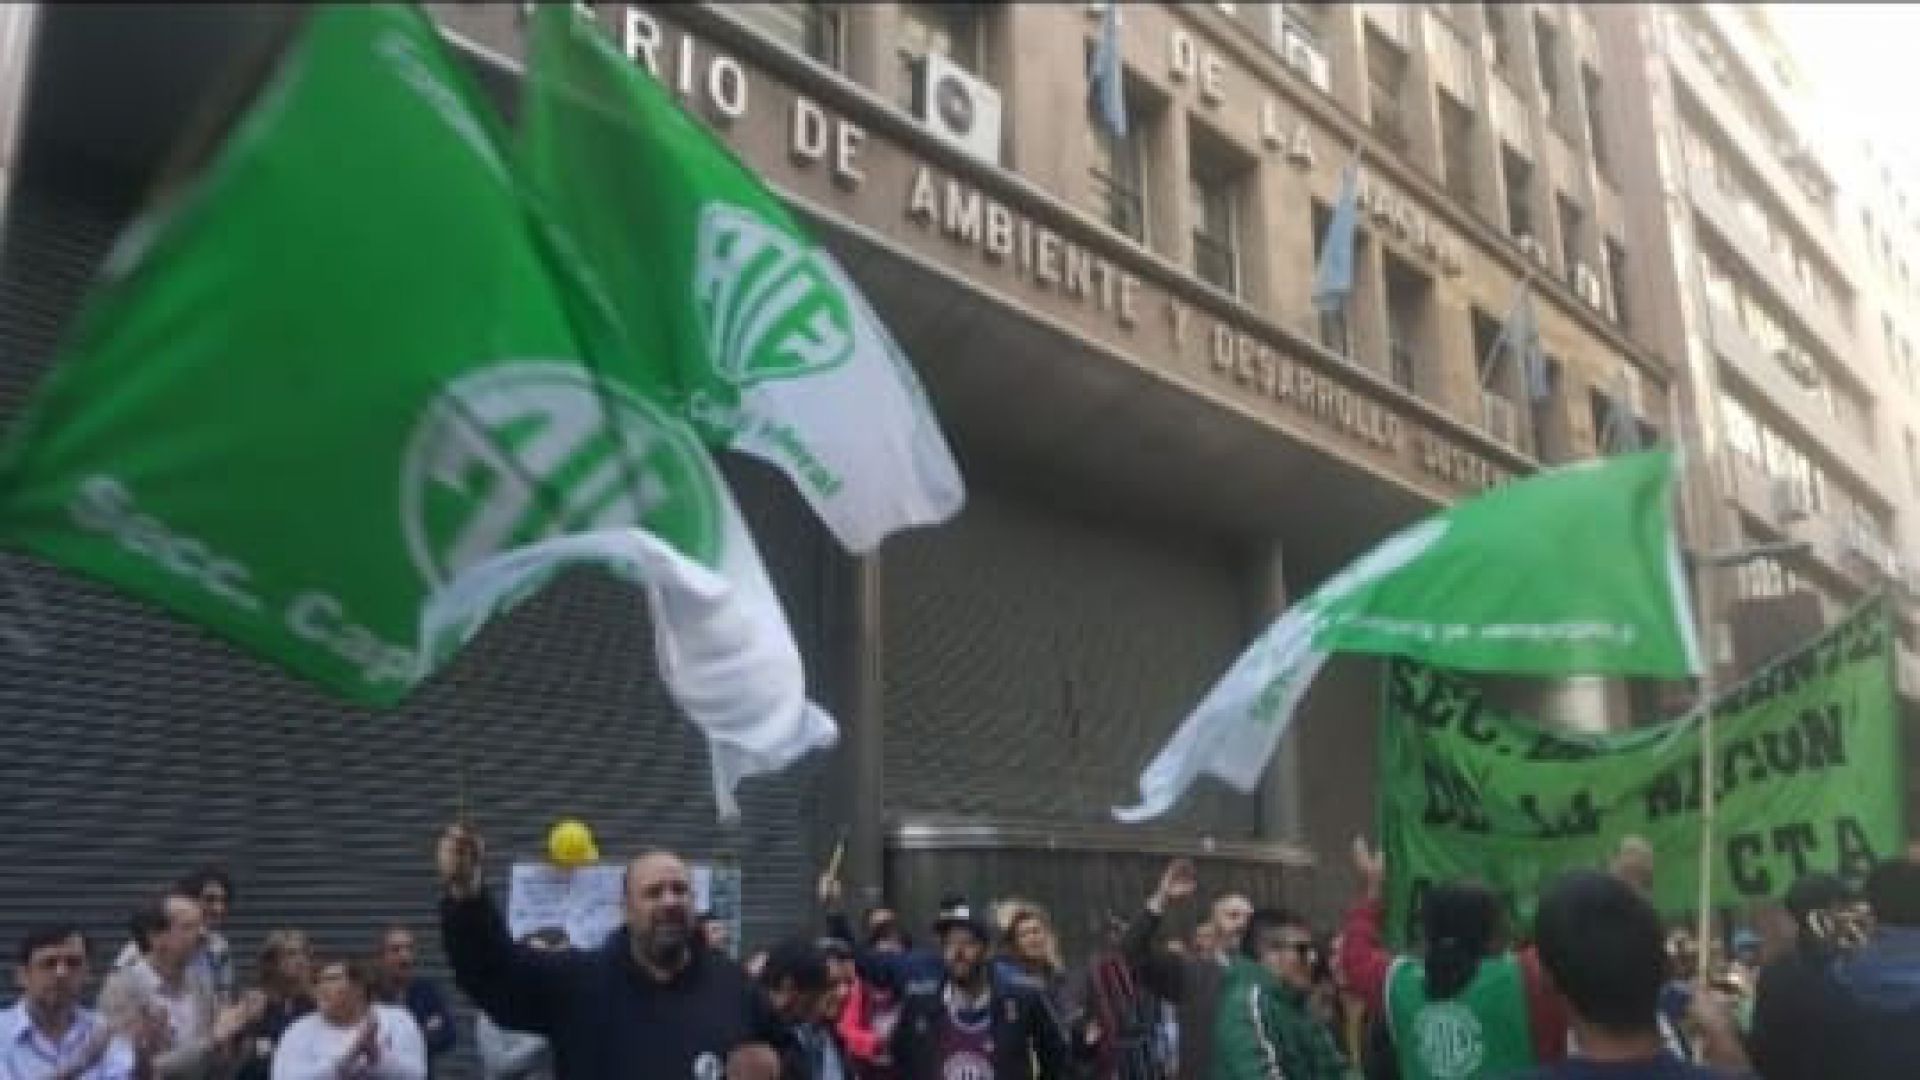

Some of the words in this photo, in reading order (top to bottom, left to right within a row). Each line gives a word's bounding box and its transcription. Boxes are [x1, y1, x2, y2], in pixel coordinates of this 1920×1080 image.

[1170, 30, 1226, 100] DE
[1262, 100, 1314, 166] LA
[793, 96, 866, 182] DE
[910, 163, 1142, 322] AMBIENTE
[1170, 298, 1191, 348] Y
[1213, 322, 1400, 448] DESARROLLO
[1646, 702, 1847, 822] NACION
[1726, 817, 1878, 898] CTA
